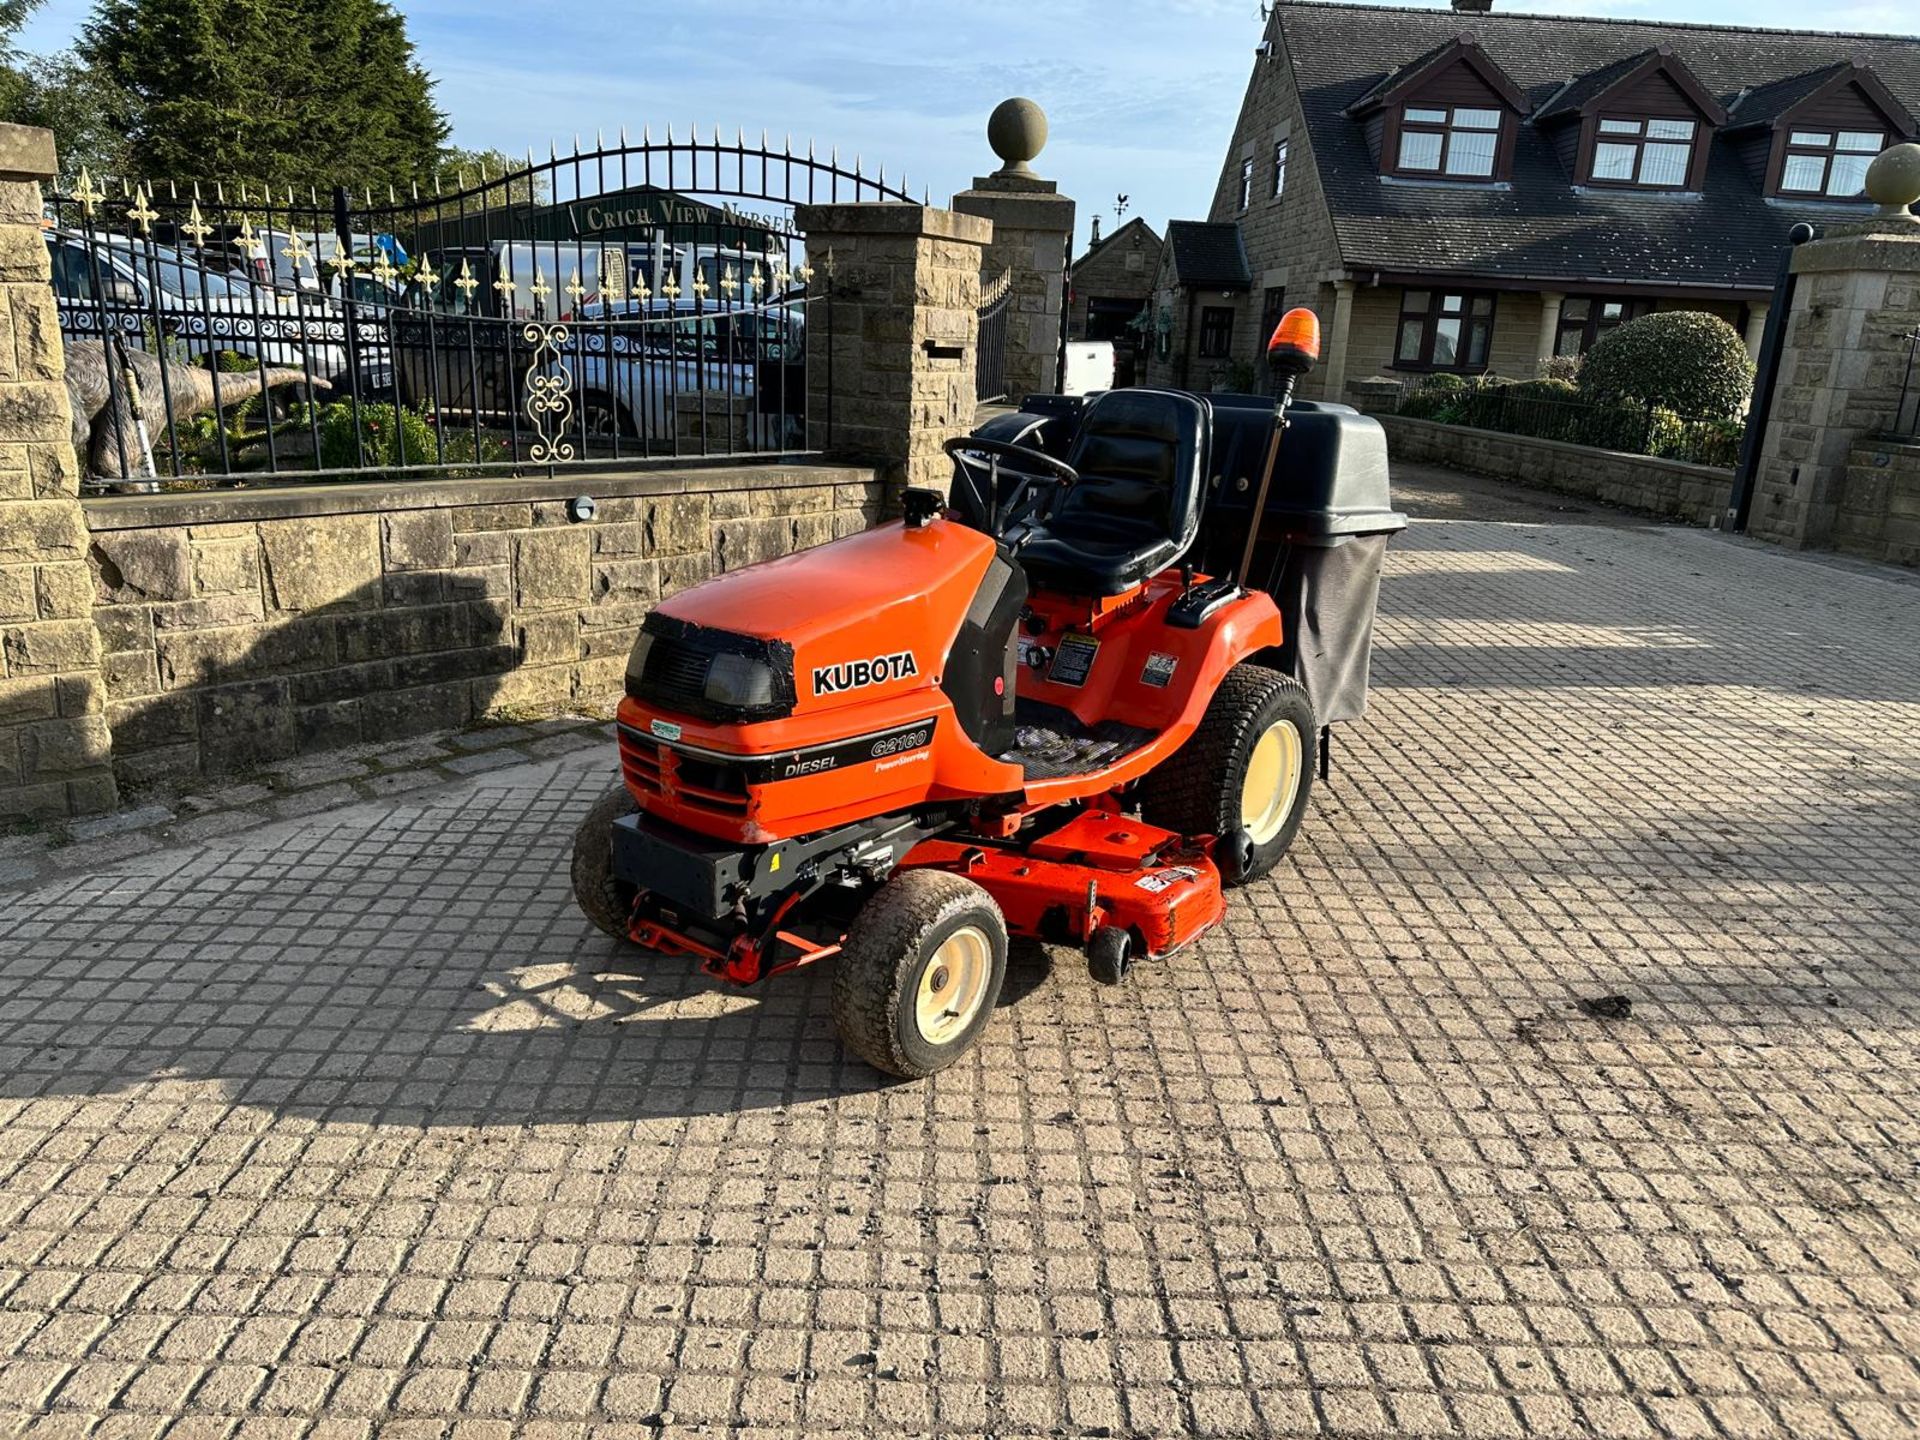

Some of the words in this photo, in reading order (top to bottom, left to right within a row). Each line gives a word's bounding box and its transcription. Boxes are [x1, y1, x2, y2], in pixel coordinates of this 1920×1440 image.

[660, 199, 710, 223] VIEW
[722, 201, 797, 236] NURSER
[813, 651, 917, 695] KUBOTA
[784, 756, 839, 777] DIESEL
[870, 729, 927, 758] G2160
